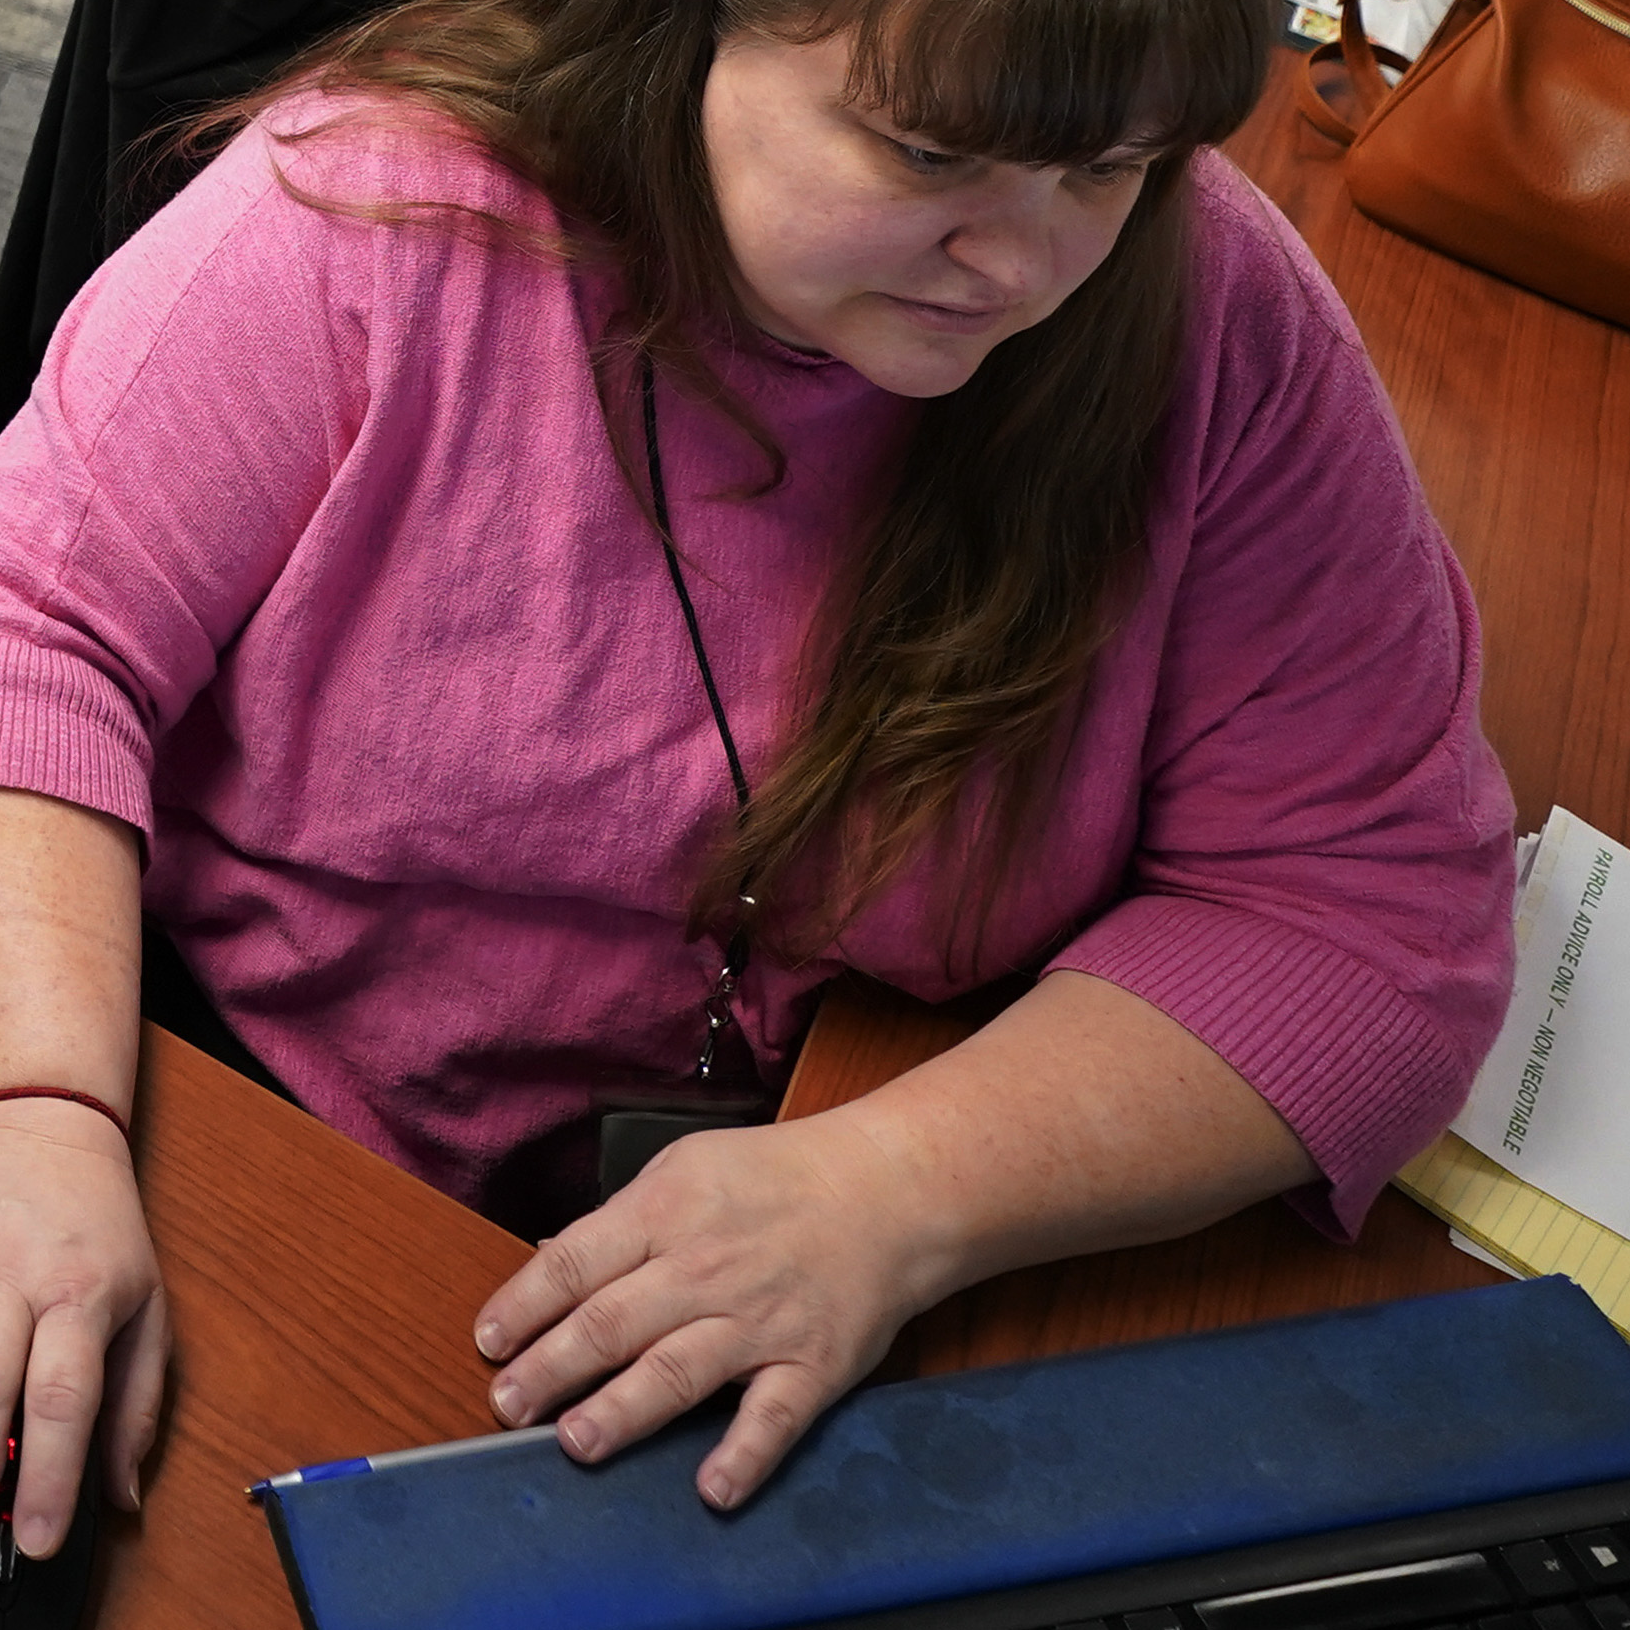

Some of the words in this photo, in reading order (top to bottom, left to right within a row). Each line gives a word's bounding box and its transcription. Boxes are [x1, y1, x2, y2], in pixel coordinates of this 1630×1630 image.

[1579, 848, 1614, 909] PAYROLL
[1559, 909, 1594, 967] ADVICE
[1545, 964, 1576, 1008] ONLY
[1530, 1023, 1557, 1059] NON
[1500, 1057, 1547, 1155] NEGOTIABLE
